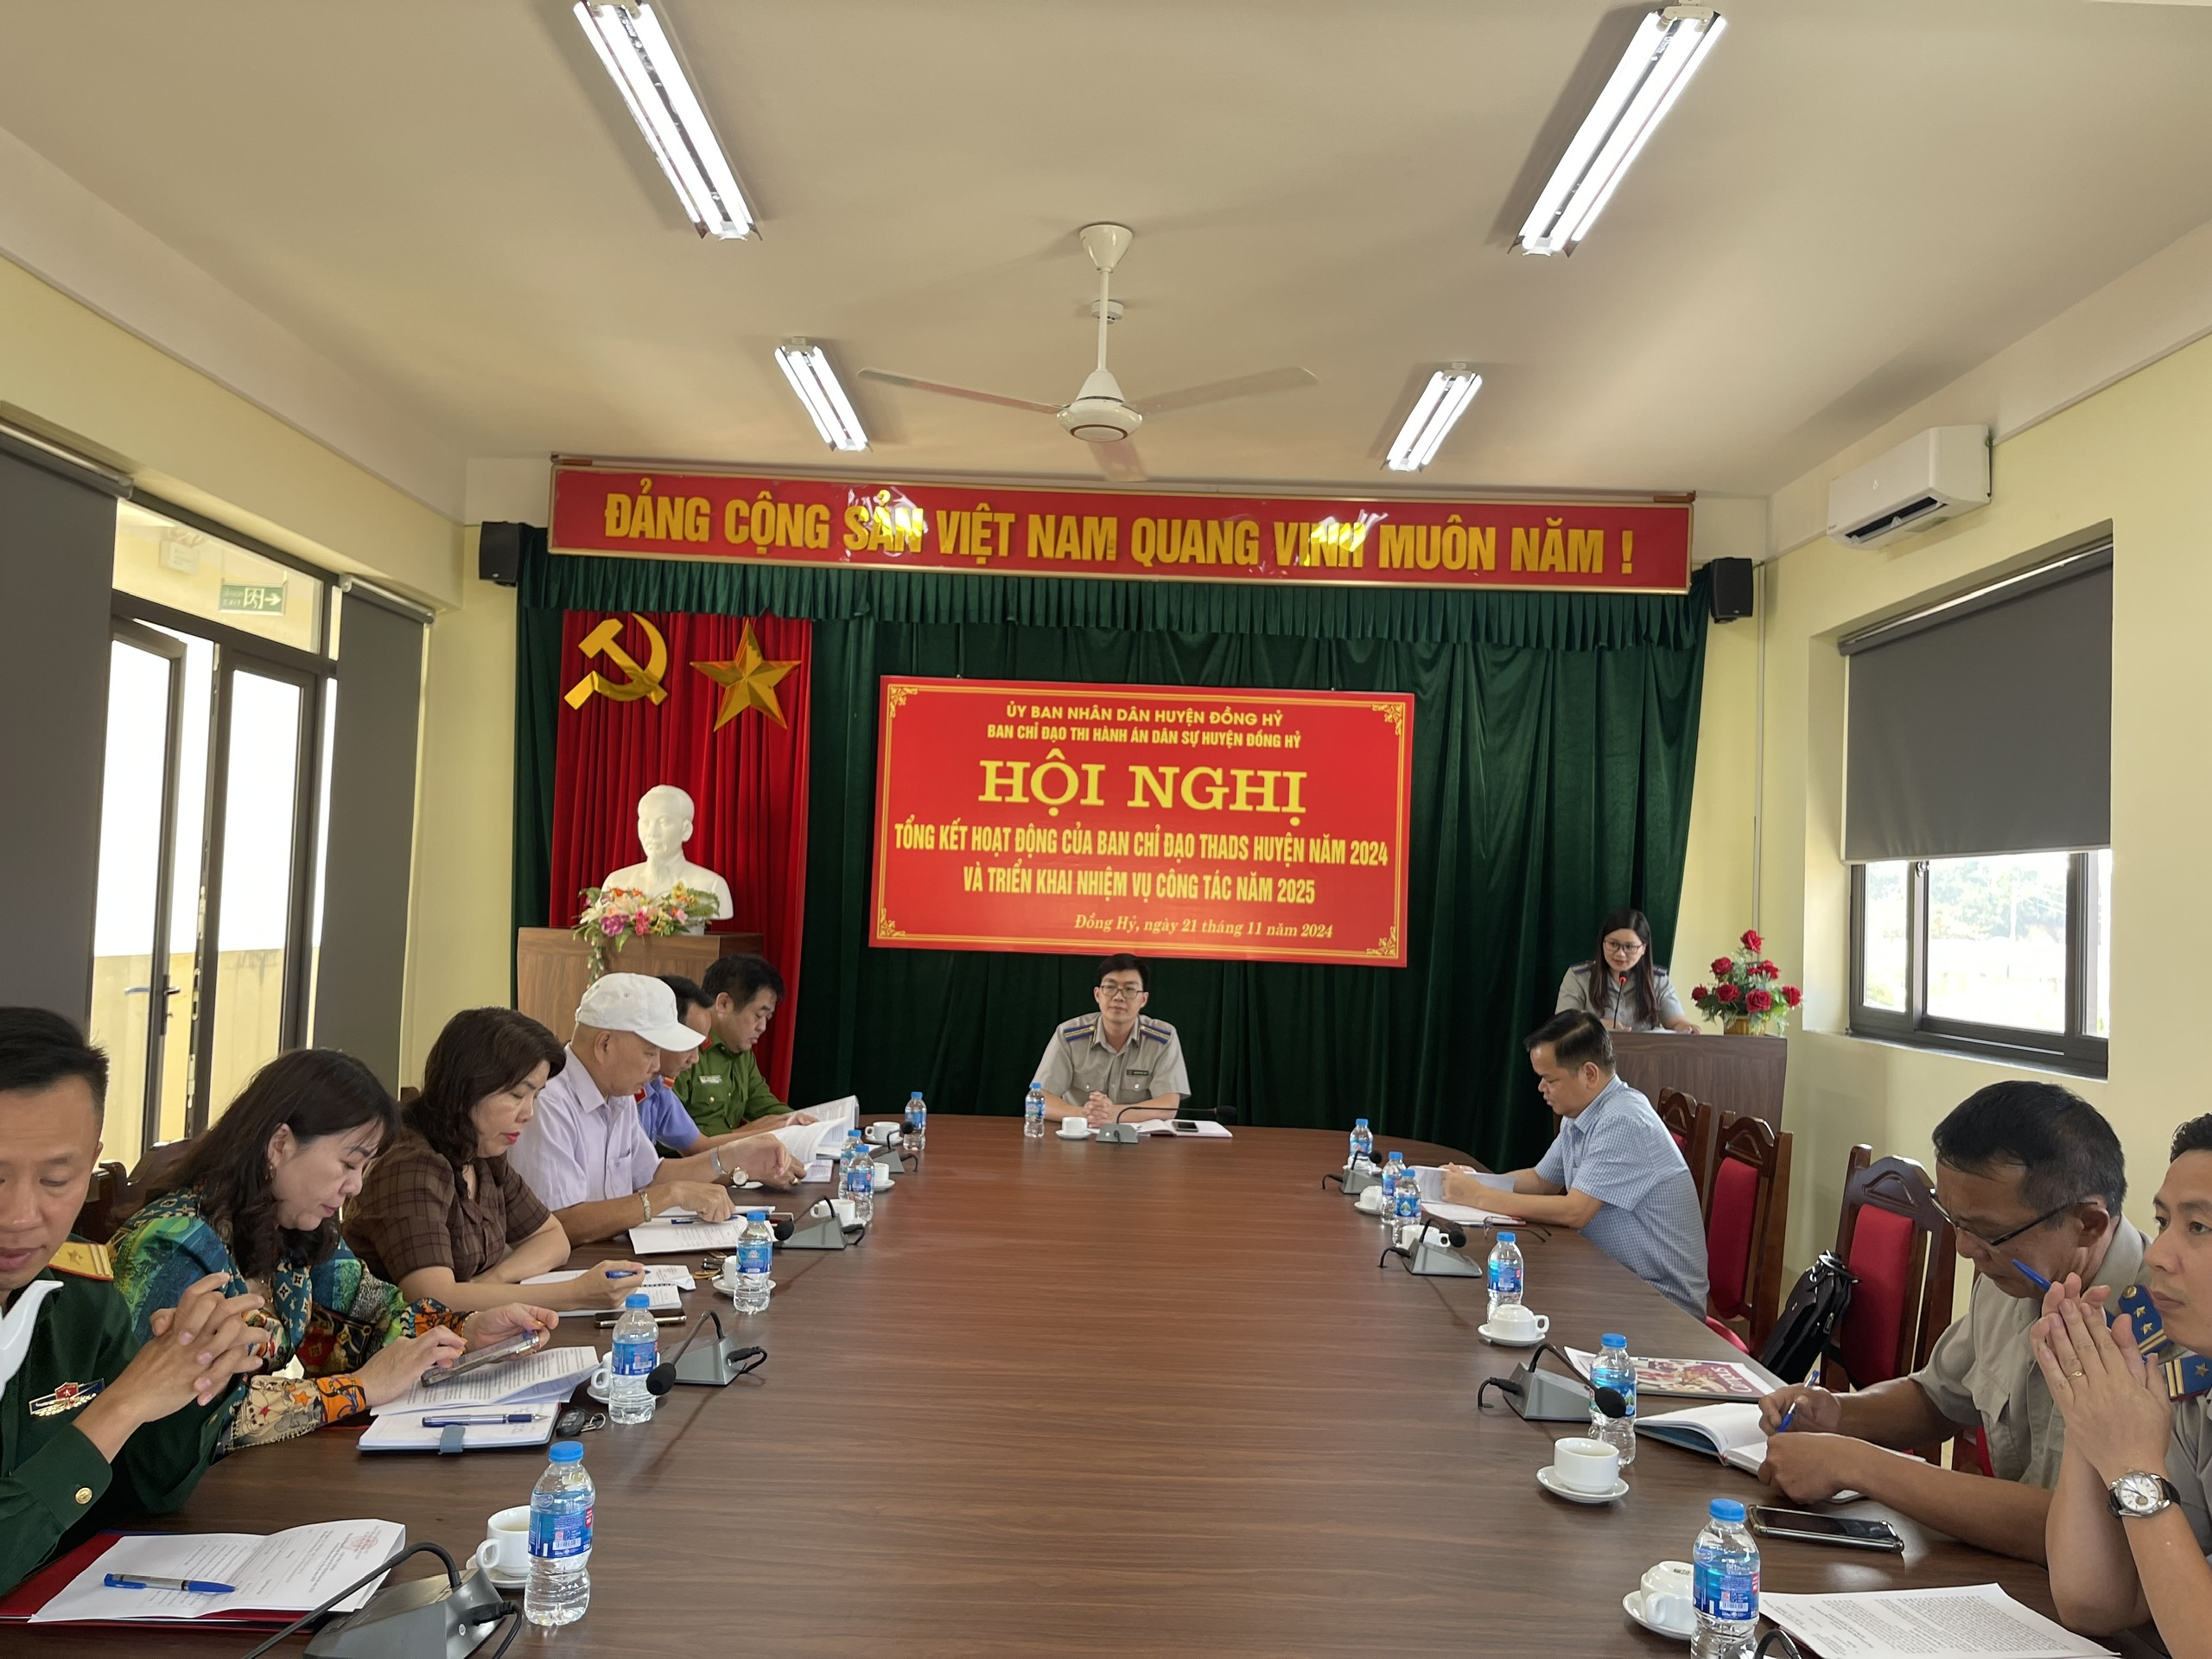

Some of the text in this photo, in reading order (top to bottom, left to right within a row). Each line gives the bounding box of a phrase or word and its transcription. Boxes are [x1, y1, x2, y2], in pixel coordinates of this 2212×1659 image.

[605, 478, 1633, 575] ĐẢNG CỘNG SẢN VIỆT NAM QUANG VINH MUÔN NĂM !
[987, 723, 1301, 749] BAN CHỈ ĐẠO THI HÀNH ÁN DÂN SỰ HUYỆN ĐỒNG HỶ
[1007, 701, 1283, 727] ỦY BAN NHÂN DÂN HUYỆN ĐỒNG HỶ
[977, 747, 1307, 828] HỘI NGHỊ
[894, 815, 1389, 868] TỔNG KẾT HOẠT ĐỘNG CỦA BAN CHỈ ĐẠO THADS HUYỆN NĂM 2024
[963, 858, 1316, 905] VÀ TRIỂN KHAI NHIỆM VỤ CÔNG TÁC NĂM 2025
[1073, 912, 1333, 939] Đồng Hỷ, ngày 21 tháng 11 năm 2024
